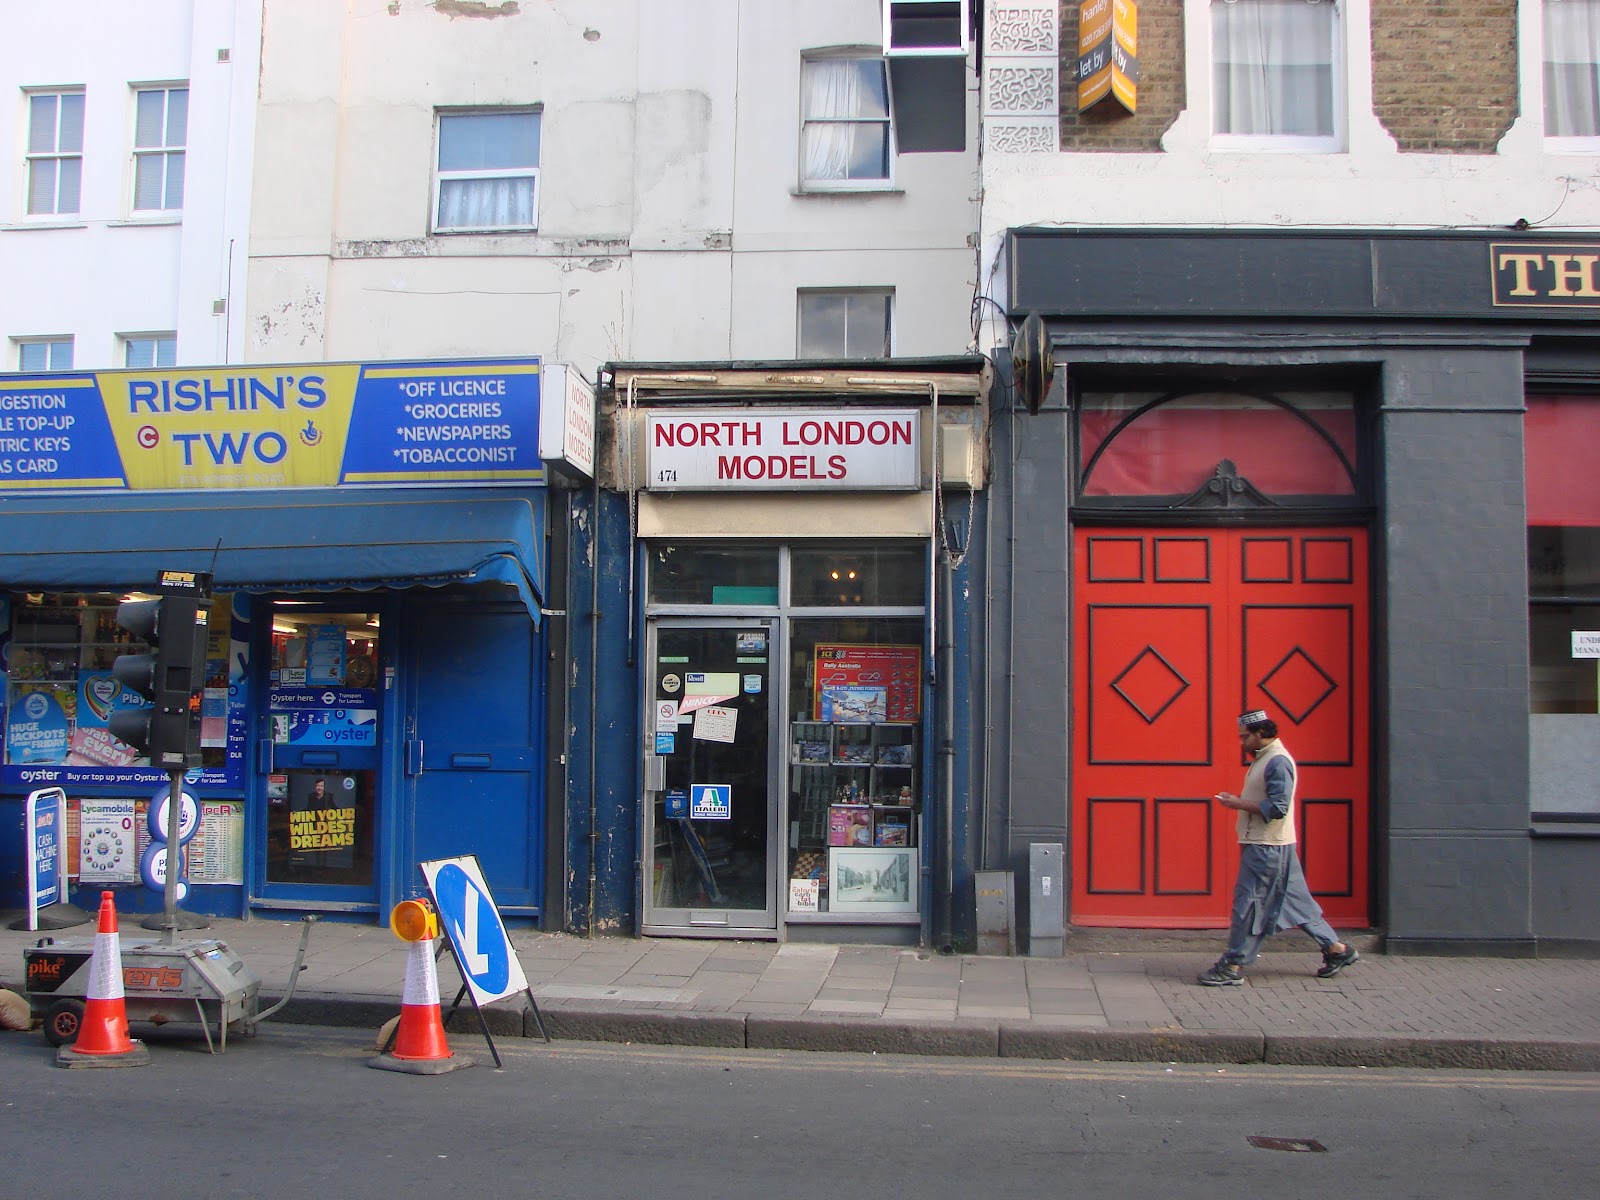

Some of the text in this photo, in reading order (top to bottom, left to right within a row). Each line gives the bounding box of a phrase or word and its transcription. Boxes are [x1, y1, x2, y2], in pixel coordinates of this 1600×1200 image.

[1082, 0, 1107, 23] hanley
[1080, 50, 1103, 78] let by
[1118, 47, 1127, 74] by
[1499, 253, 1600, 297] TH
[128, 375, 327, 413] RISHIN'S
[441, 379, 506, 396] LICENCE
[0, 394, 66, 410] GESTION
[572, 384, 591, 415] NORTH
[17, 415, 76, 431] TOP-UP
[569, 406, 592, 440] LONDON
[655, 421, 912, 447] NORTH LONDON
[35, 436, 71, 452] KEYS
[172, 431, 288, 466] TWO
[569, 432, 592, 465] MODELS
[17, 458, 58, 473] CARD
[718, 455, 847, 480] MODELS
[657, 469, 678, 482] 474
[687, 674, 704, 682] Revell
[123, 694, 145, 706] Play
[271, 694, 316, 703] Oyster here.
[683, 696, 716, 708] NINCO
[10, 722, 39, 733] HUGE
[232, 718, 243, 726] Bus
[10, 729, 66, 744] JACKPOTS
[32, 738, 66, 749] FRIDAY
[324, 728, 370, 743] oyster
[84, 736, 131, 766] every
[21, 769, 60, 783] oyster
[67, 773, 80, 781] Buy
[91, 774, 104, 782] top
[105, 774, 115, 782] up
[134, 774, 158, 782] Oyster
[160, 774, 172, 782] he
[81, 804, 134, 814] Lycamobile
[289, 808, 355, 823] WIN YOUR
[289, 820, 355, 835] WILDEST
[38, 833, 52, 847] CASH
[290, 833, 354, 849] DREAMS
[36, 845, 57, 861] MACHINE
[39, 858, 52, 873] HERE
[28, 959, 60, 977] pike
